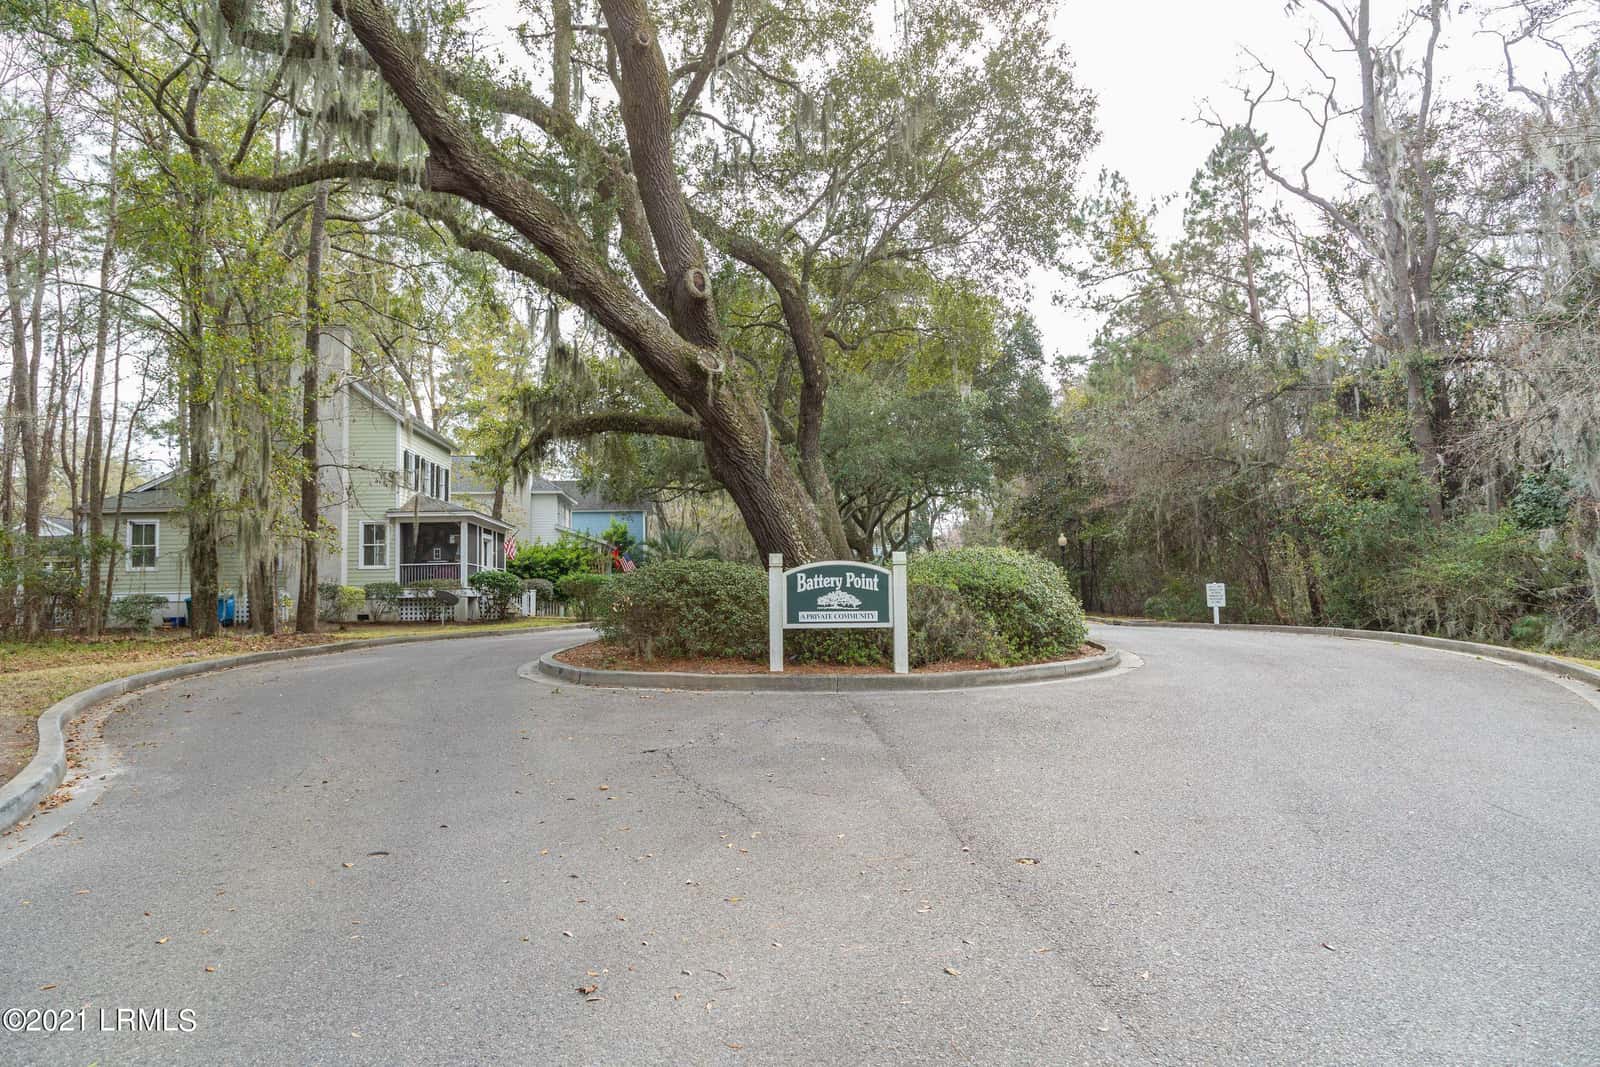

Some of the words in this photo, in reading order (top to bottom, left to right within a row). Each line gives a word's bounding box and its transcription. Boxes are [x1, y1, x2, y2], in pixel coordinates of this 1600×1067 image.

[796, 572, 843, 593] Battery
[845, 571, 880, 592] Point
[806, 612, 832, 620] PRIVATE
[833, 612, 875, 620] COMMUNITY
